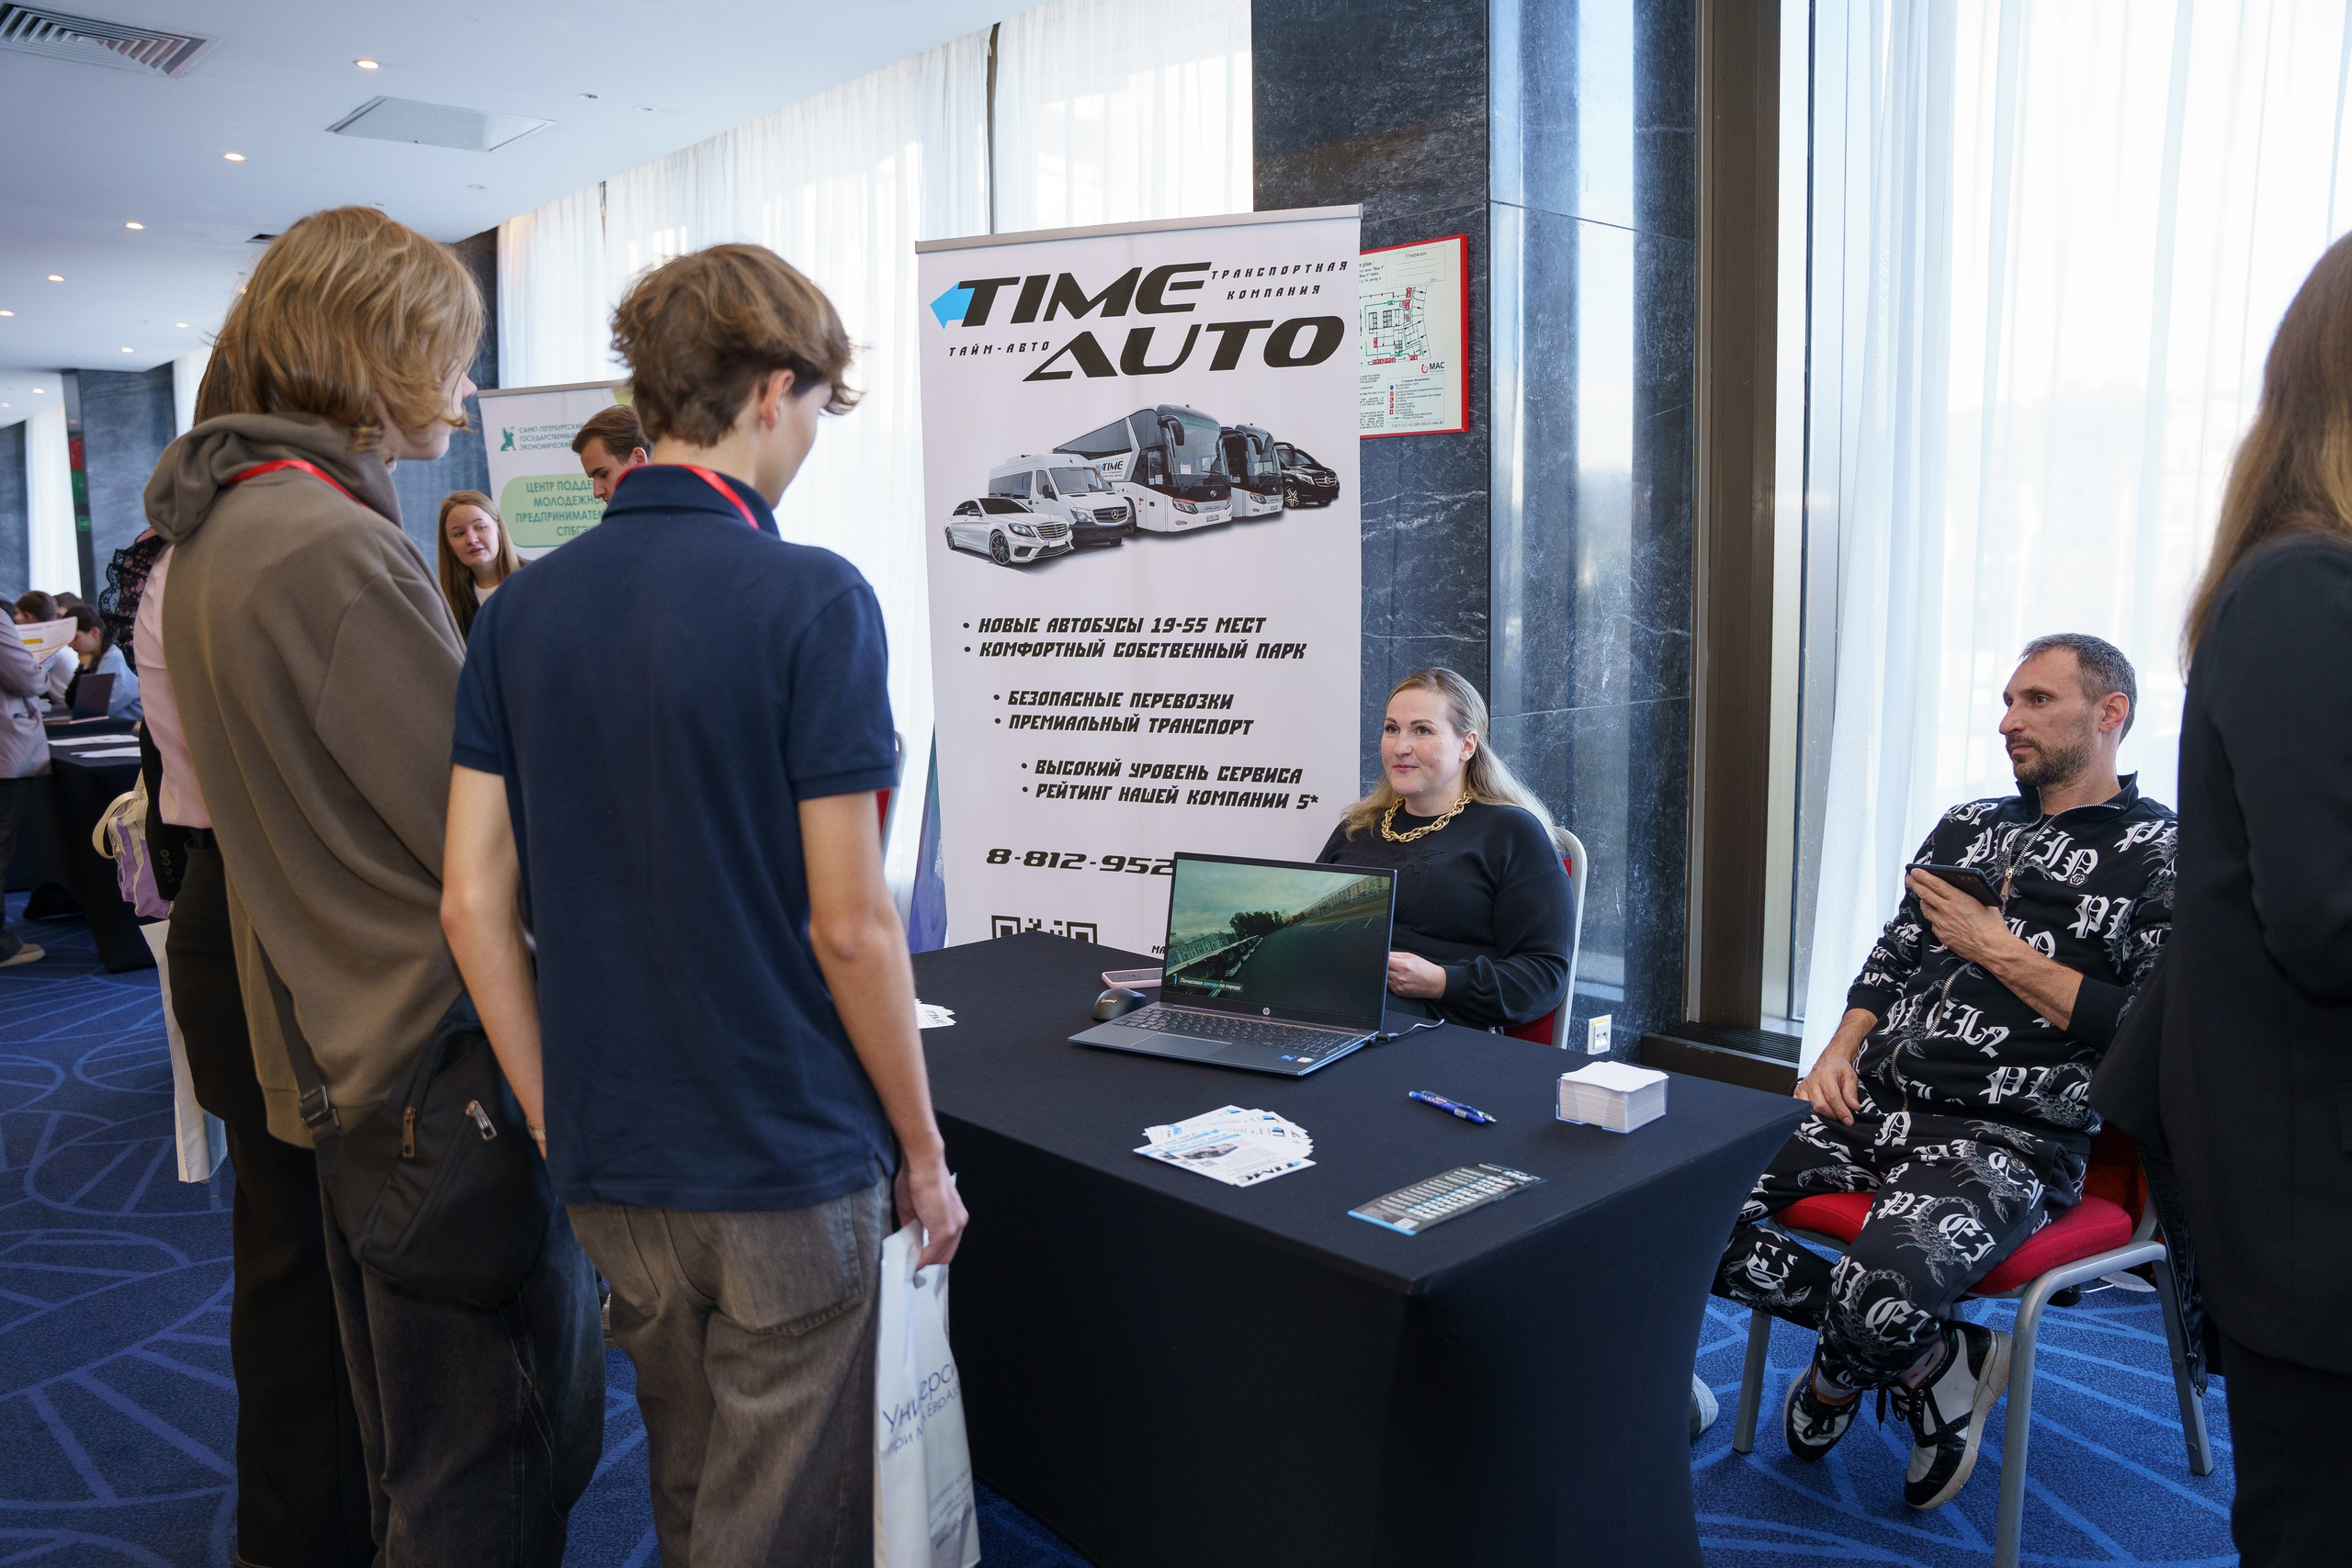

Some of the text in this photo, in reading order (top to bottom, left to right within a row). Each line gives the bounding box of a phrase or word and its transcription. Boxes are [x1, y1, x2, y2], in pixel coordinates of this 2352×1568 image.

[1211, 261, 1348, 280] ТРАНСПОРТНАЯ
[957, 262, 1212, 328] TIME
[1227, 285, 1320, 300] КОМПАНИЯ
[949, 341, 1050, 357] ТАЙМ-АВТО
[1023, 316, 1345, 382] AUTO
[1102, 460, 1125, 471] TIME
[526, 481, 555, 493] ЦЕНТР
[978, 617, 1266, 633] НОВЫЕ АВТОБУСЫ 19-55 МЕСТ
[979, 638, 1306, 659] КОМФОРТНЫЙ СОБСТВЕННЫЙ ПАРК
[1008, 691, 1234, 709] БЕЗОПАСНЫЕ ПЕРЕВОЗКИ
[1009, 714, 1254, 735] ПРЕМИАЛЬНЫЙ ТРАНСПОРТ
[1035, 759, 1303, 784] ВЫСОКИЙ УРОВЕНЬ СЕРВИСА
[1035, 782, 1113, 800] РЕЙТИНГ
[1118, 785, 1179, 804] НАШЕЙ
[1186, 790, 1290, 808] КОМПАНИИ
[1181, 977, 1203, 986] Почасовая
